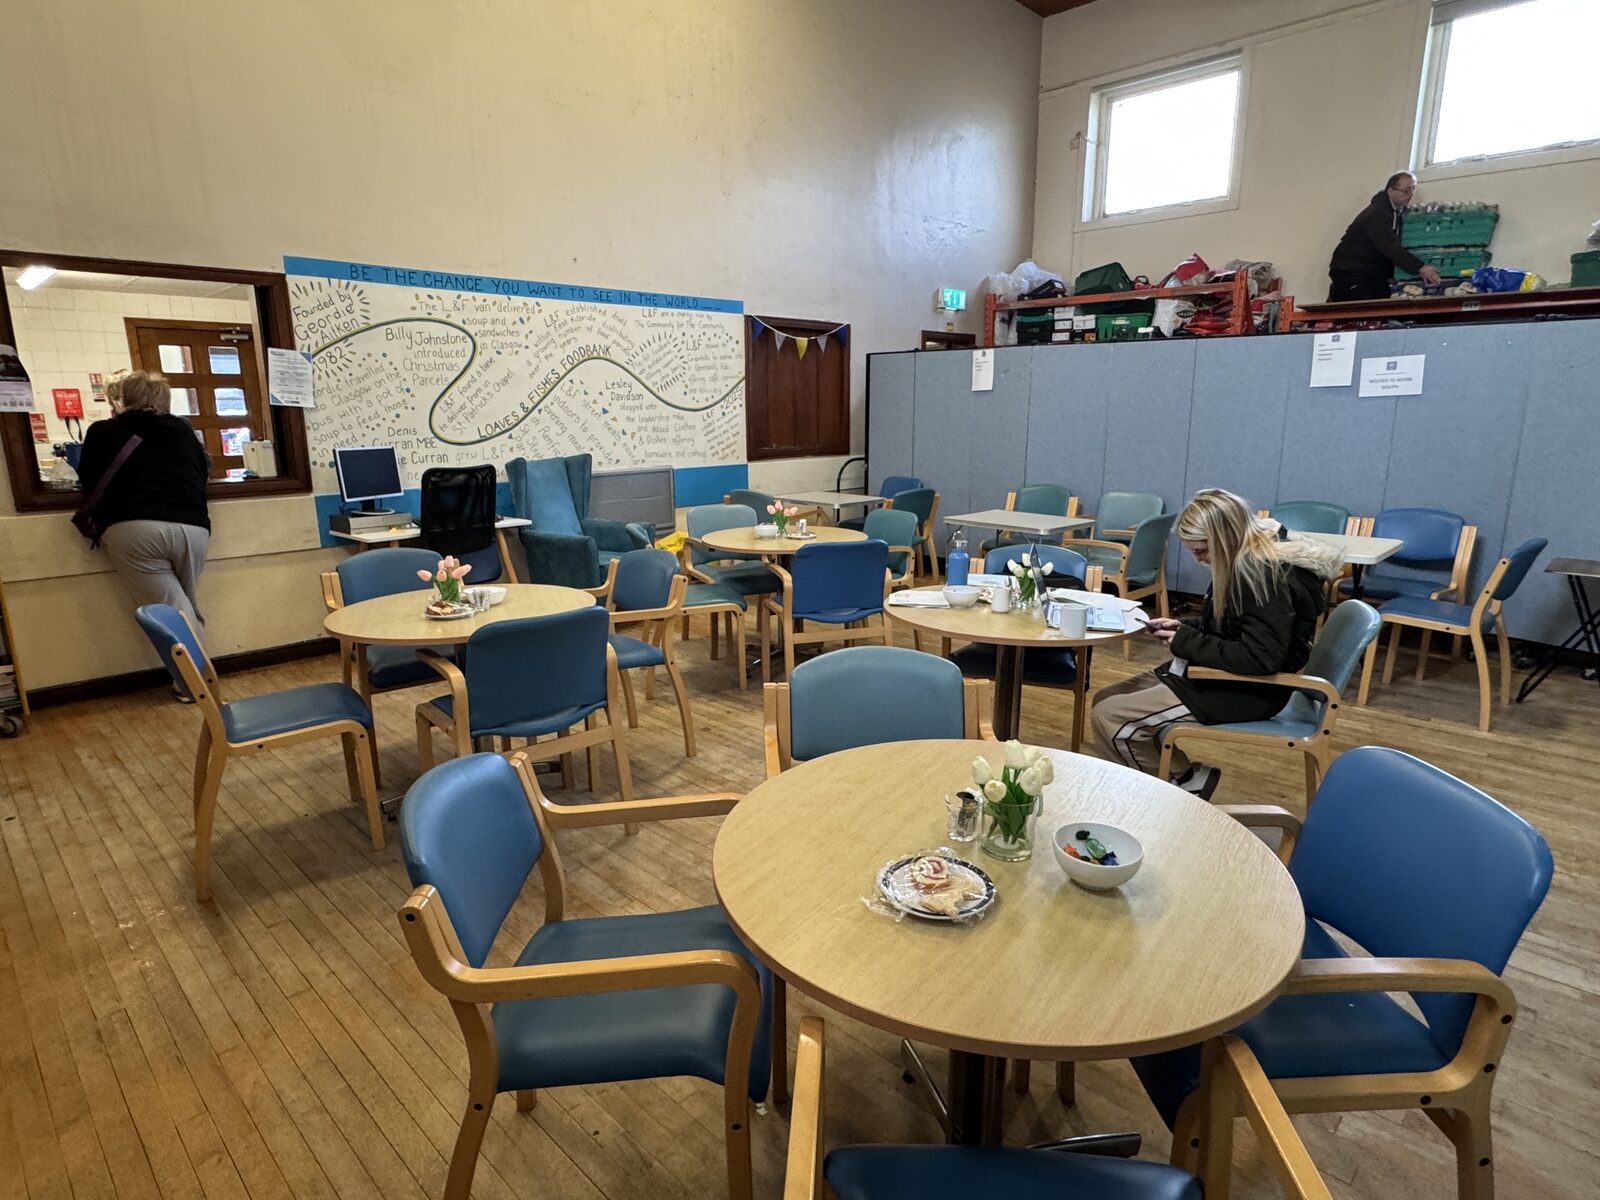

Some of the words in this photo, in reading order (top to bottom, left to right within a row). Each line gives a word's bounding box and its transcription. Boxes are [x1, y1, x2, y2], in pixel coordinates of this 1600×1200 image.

[349, 264, 371, 281] BE
[382, 267, 418, 286] THE
[422, 273, 483, 291] CHANGE
[491, 280, 520, 295] YOU
[527, 283, 562, 296] WANT
[568, 288, 585, 299] TO
[593, 290, 613, 302] SEE
[620, 292, 631, 304] IN
[639, 293, 658, 306] THE
[292, 294, 335, 322] Founded
[336, 290, 354, 306] by
[418, 301, 437, 311] The
[442, 299, 470, 312] L&F
[475, 303, 491, 312] van
[497, 301, 536, 314] delivered
[543, 310, 560, 328] L&F
[565, 303, 607, 317] established
[642, 308, 657, 318] L&F
[294, 304, 355, 341] Geordie
[320, 318, 360, 344] Aitken
[478, 327, 520, 337] sandwiches
[490, 317, 506, 326] and
[385, 326, 413, 350] Billy
[414, 331, 468, 346] Johnstone
[480, 342, 488, 350] in
[491, 340, 523, 356] Glasgow
[686, 339, 702, 351] L&F
[313, 346, 347, 372] 1982
[414, 347, 466, 359] introduced
[402, 357, 460, 372] Christmas
[313, 383, 342, 399] eordie
[345, 364, 385, 387] travelled
[331, 385, 372, 407] Glasgow
[375, 380, 386, 388] on
[386, 371, 402, 381] the
[412, 373, 449, 386] Parcels
[439, 393, 455, 413] L&F
[457, 375, 477, 398] found
[478, 356, 495, 373] base
[492, 368, 514, 393] Chapel
[560, 382, 581, 399] L&F
[605, 378, 632, 393] Lesley
[477, 410, 520, 439] LOAVES
[519, 402, 529, 413] &
[527, 368, 561, 405] FISHES
[560, 343, 611, 371] FOODBANK
[610, 391, 644, 401] Davidson
[724, 385, 743, 409] 2025
[308, 416, 334, 431] bus
[338, 404, 362, 419] with
[366, 399, 373, 408] a
[376, 388, 393, 406] pot
[439, 423, 448, 433] to
[446, 402, 468, 424] deliver
[467, 387, 483, 406] from
[483, 379, 491, 389] in
[620, 402, 643, 414] stepped
[645, 402, 657, 410] into
[701, 409, 714, 421] L&F
[313, 430, 340, 445] soup
[341, 423, 353, 432] to
[356, 411, 380, 430] feed
[384, 399, 407, 413] those
[387, 426, 418, 437] Denis
[520, 423, 530, 437] St
[531, 416, 541, 426] in
[543, 404, 568, 437] evening
[553, 394, 581, 423] indoors
[579, 420, 588, 433] to
[587, 433, 614, 465] provide
[317, 447, 329, 459] in
[332, 433, 359, 449] need
[416, 437, 438, 449] MBE
[411, 451, 449, 464] Curran
[455, 452, 477, 465] grew
[482, 444, 507, 460] L&F
